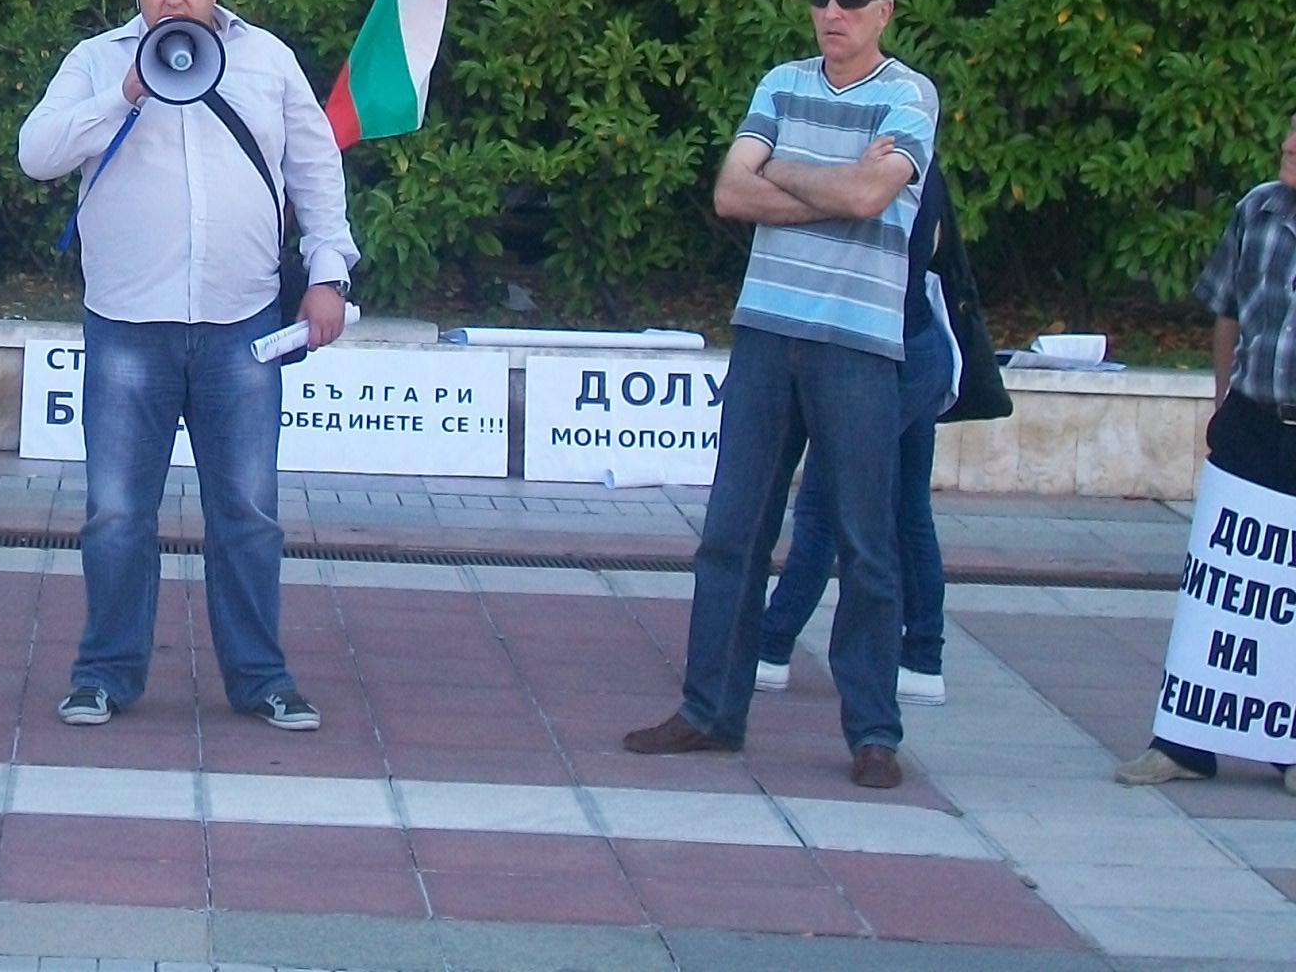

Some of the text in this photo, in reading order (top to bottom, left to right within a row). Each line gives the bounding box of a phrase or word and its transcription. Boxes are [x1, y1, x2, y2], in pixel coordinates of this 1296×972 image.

[1209, 507, 1296, 568] ДОЛ
[1207, 630, 1258, 677] НА
[1161, 669, 1296, 740] ЕШАРС
